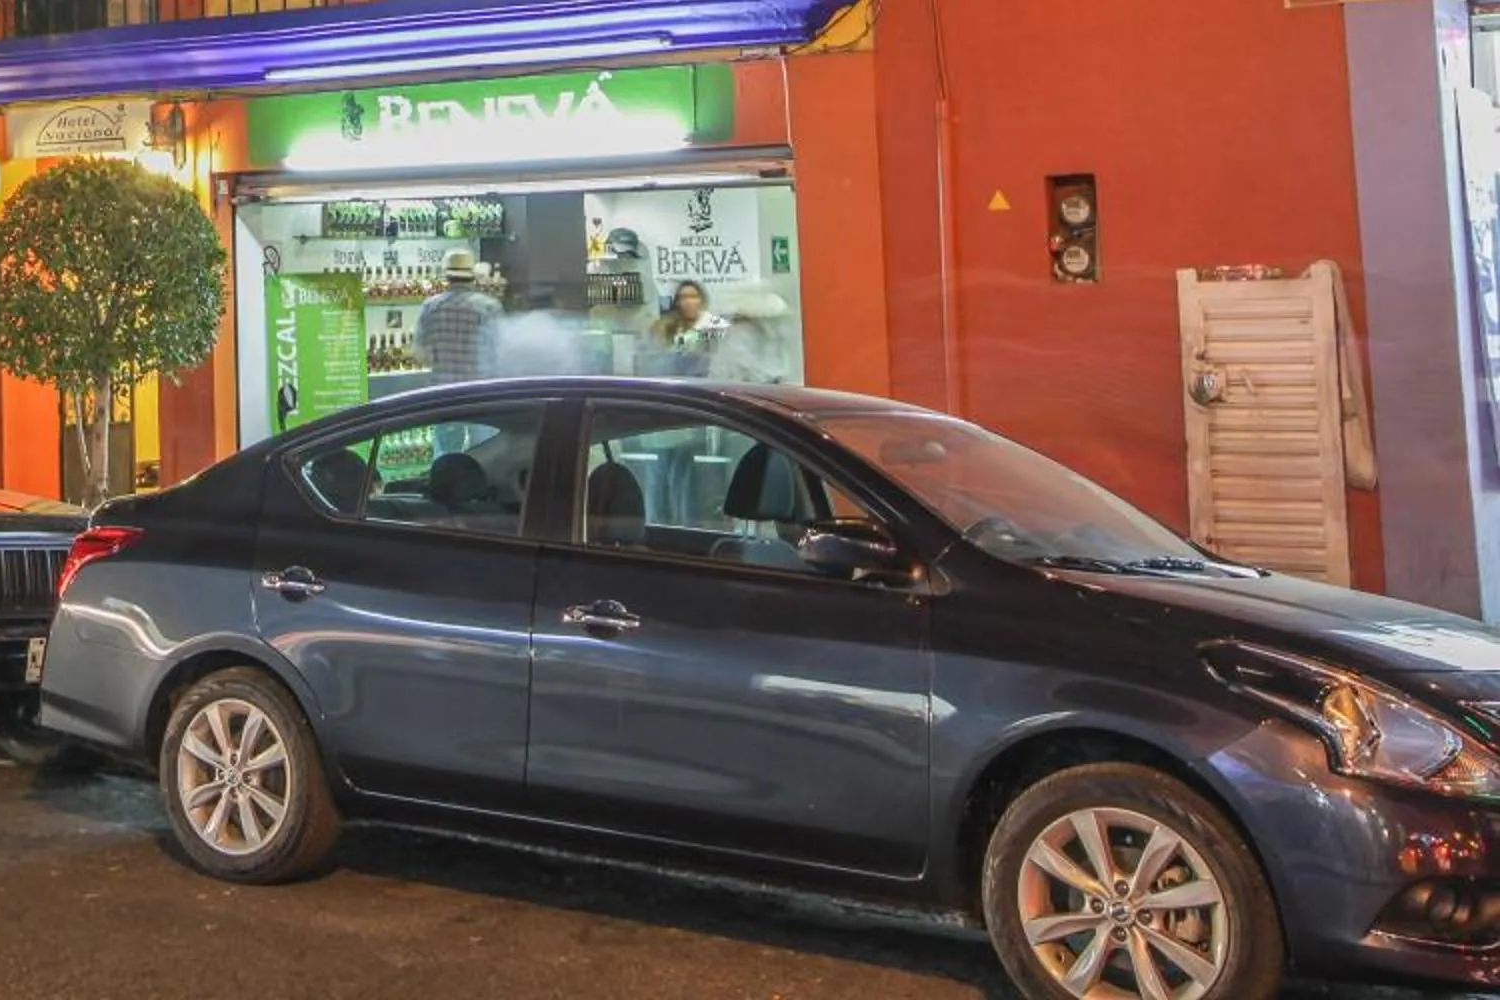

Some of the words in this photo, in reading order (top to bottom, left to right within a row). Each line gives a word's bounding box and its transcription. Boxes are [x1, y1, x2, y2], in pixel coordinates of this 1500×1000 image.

[56, 114, 97, 129] Hotel
[44, 125, 122, 141] Nacional
[679, 235, 723, 247] MEZCAL
[656, 240, 749, 275] BENEVÁ
[275, 310, 300, 415] EZCAL
